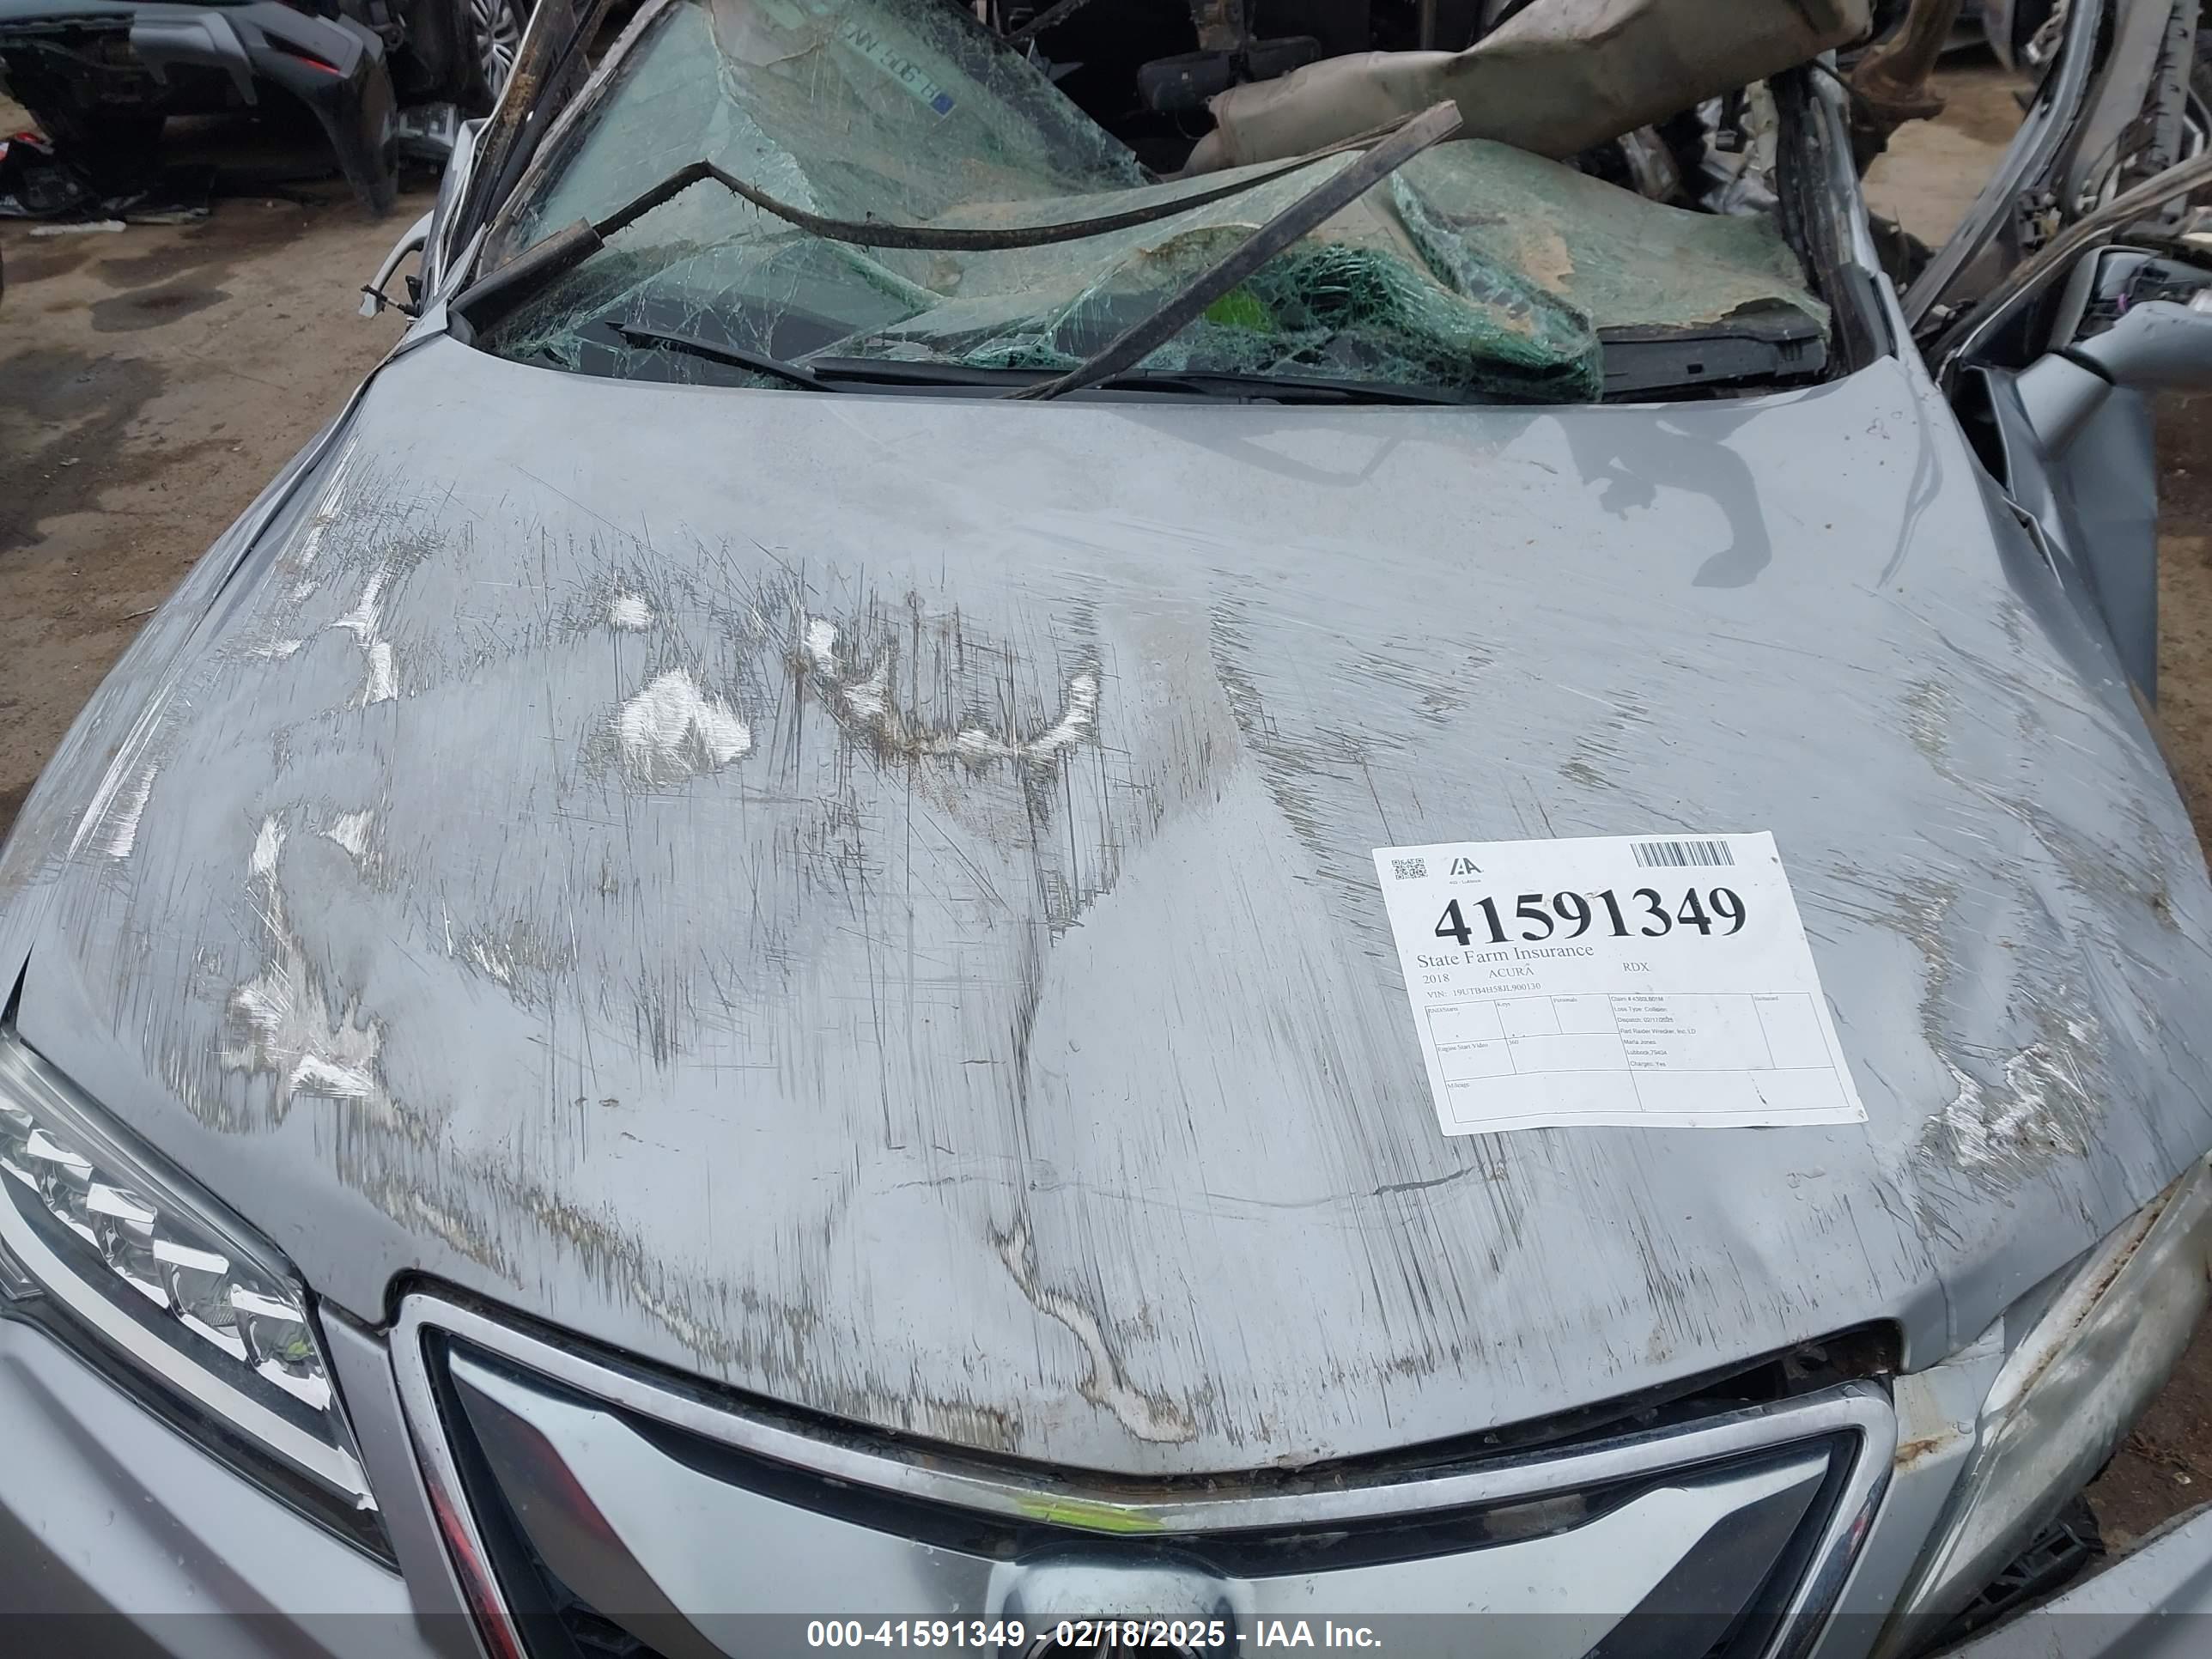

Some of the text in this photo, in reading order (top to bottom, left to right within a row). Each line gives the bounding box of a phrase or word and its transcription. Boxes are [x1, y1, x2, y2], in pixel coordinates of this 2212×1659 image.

[1435, 887, 1747, 945] 41591349
[1417, 945, 1595, 969] State Farm Insurance
[1422, 962, 1651, 985] 2018 ACURA RDX
[1426, 990, 1448, 1000] VIN:
